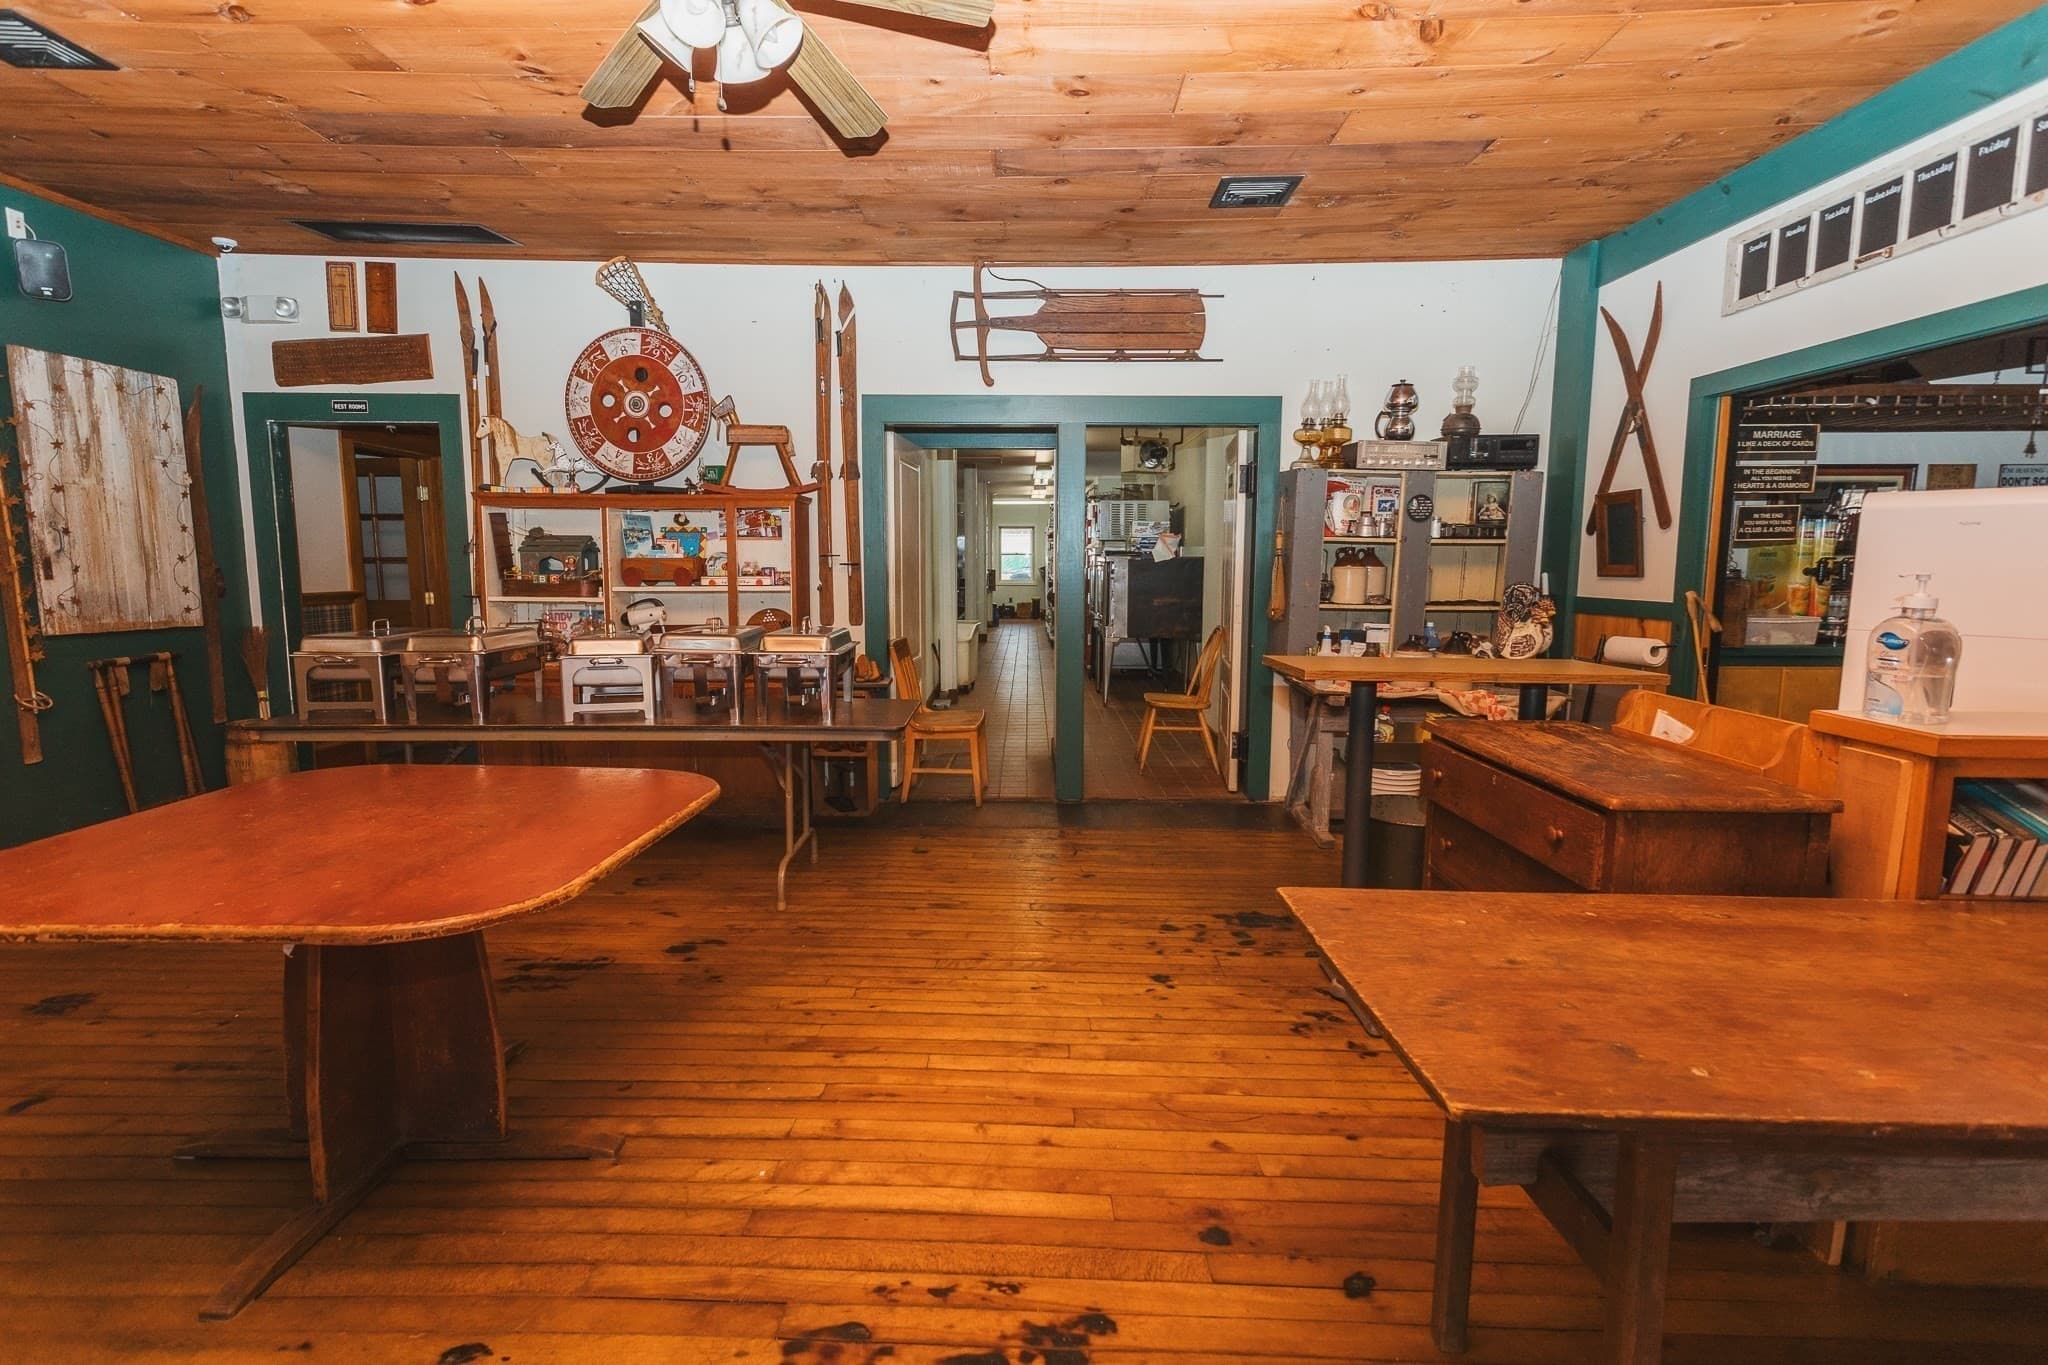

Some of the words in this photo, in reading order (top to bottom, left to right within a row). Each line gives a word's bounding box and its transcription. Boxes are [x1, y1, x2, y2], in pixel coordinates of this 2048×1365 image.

[1978, 137, 2011, 157] Friday
[1917, 161, 1954, 183] Thursday
[1752, 430, 1803, 439] MARRIAGE
[2001, 477, 2031, 487] DON'T
[2032, 477, 2048, 486] SC
